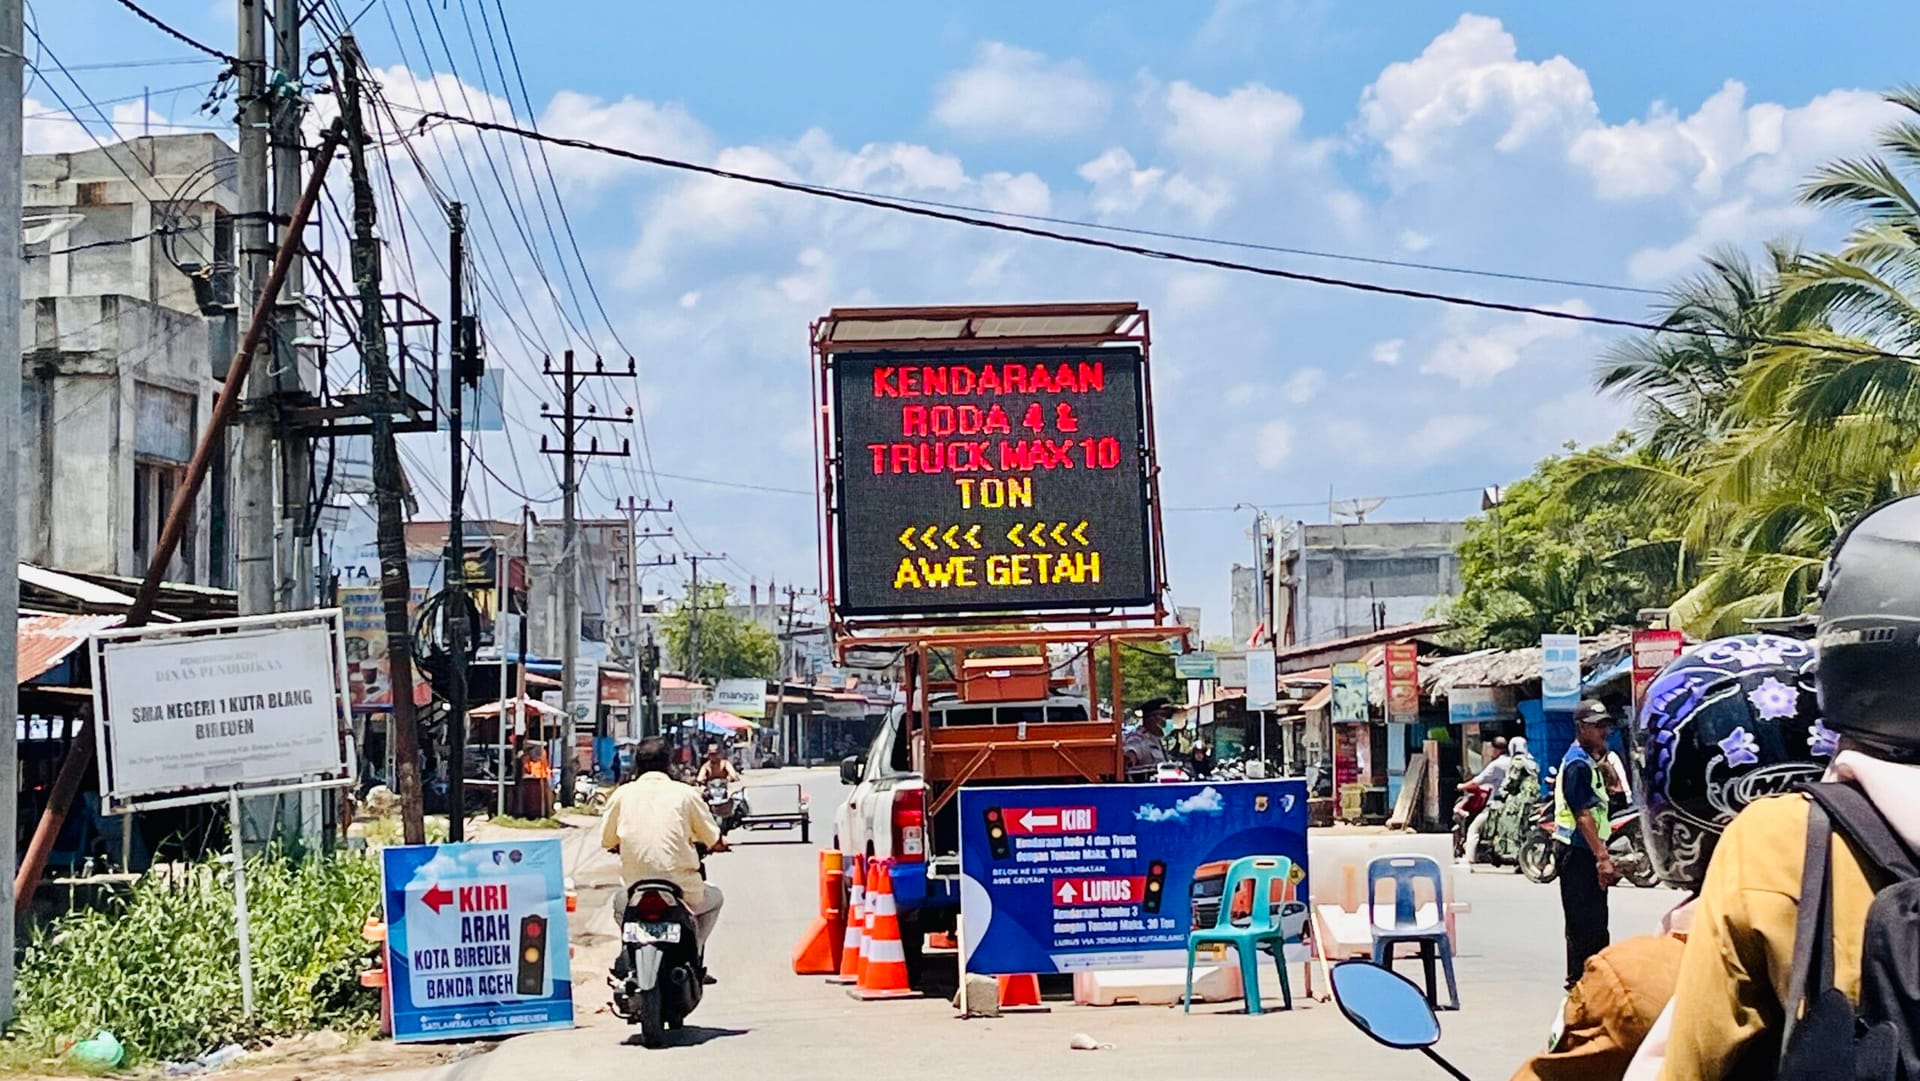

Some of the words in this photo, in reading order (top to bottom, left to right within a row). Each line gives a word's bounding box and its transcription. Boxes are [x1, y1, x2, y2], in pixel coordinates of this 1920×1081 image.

[873, 361, 1105, 398] KENDARAAN
[903, 402, 1011, 437] RODA
[1023, 402, 1045, 433] 4
[1056, 402, 1079, 432] &
[867, 441, 994, 475] TRUCK
[1000, 439, 1074, 472] MAX
[1080, 436, 1121, 469] 10
[955, 477, 1033, 509] TON
[894, 555, 977, 589] AWE
[986, 552, 1100, 587] GETAH
[155, 669, 197, 682] DINAS
[132, 706, 164, 723] SMA
[167, 700, 215, 719] NEGERI
[220, 700, 226, 714] 1
[229, 695, 264, 713] KUTA
[268, 689, 313, 709] BLANG
[195, 718, 254, 740] BIREUEN
[1061, 809, 1092, 831] KIRI
[1086, 837, 1093, 847] 4
[1112, 834, 1137, 846] Truck
[459, 885, 508, 912] KIRI
[1082, 880, 1131, 902] LURUS
[1131, 906, 1138, 917] 3
[461, 914, 510, 943] ARAH
[414, 949, 450, 971] KOTA
[454, 945, 511, 966] BIREUEN
[427, 977, 474, 1000] BANDA
[478, 974, 514, 996] ACEH
